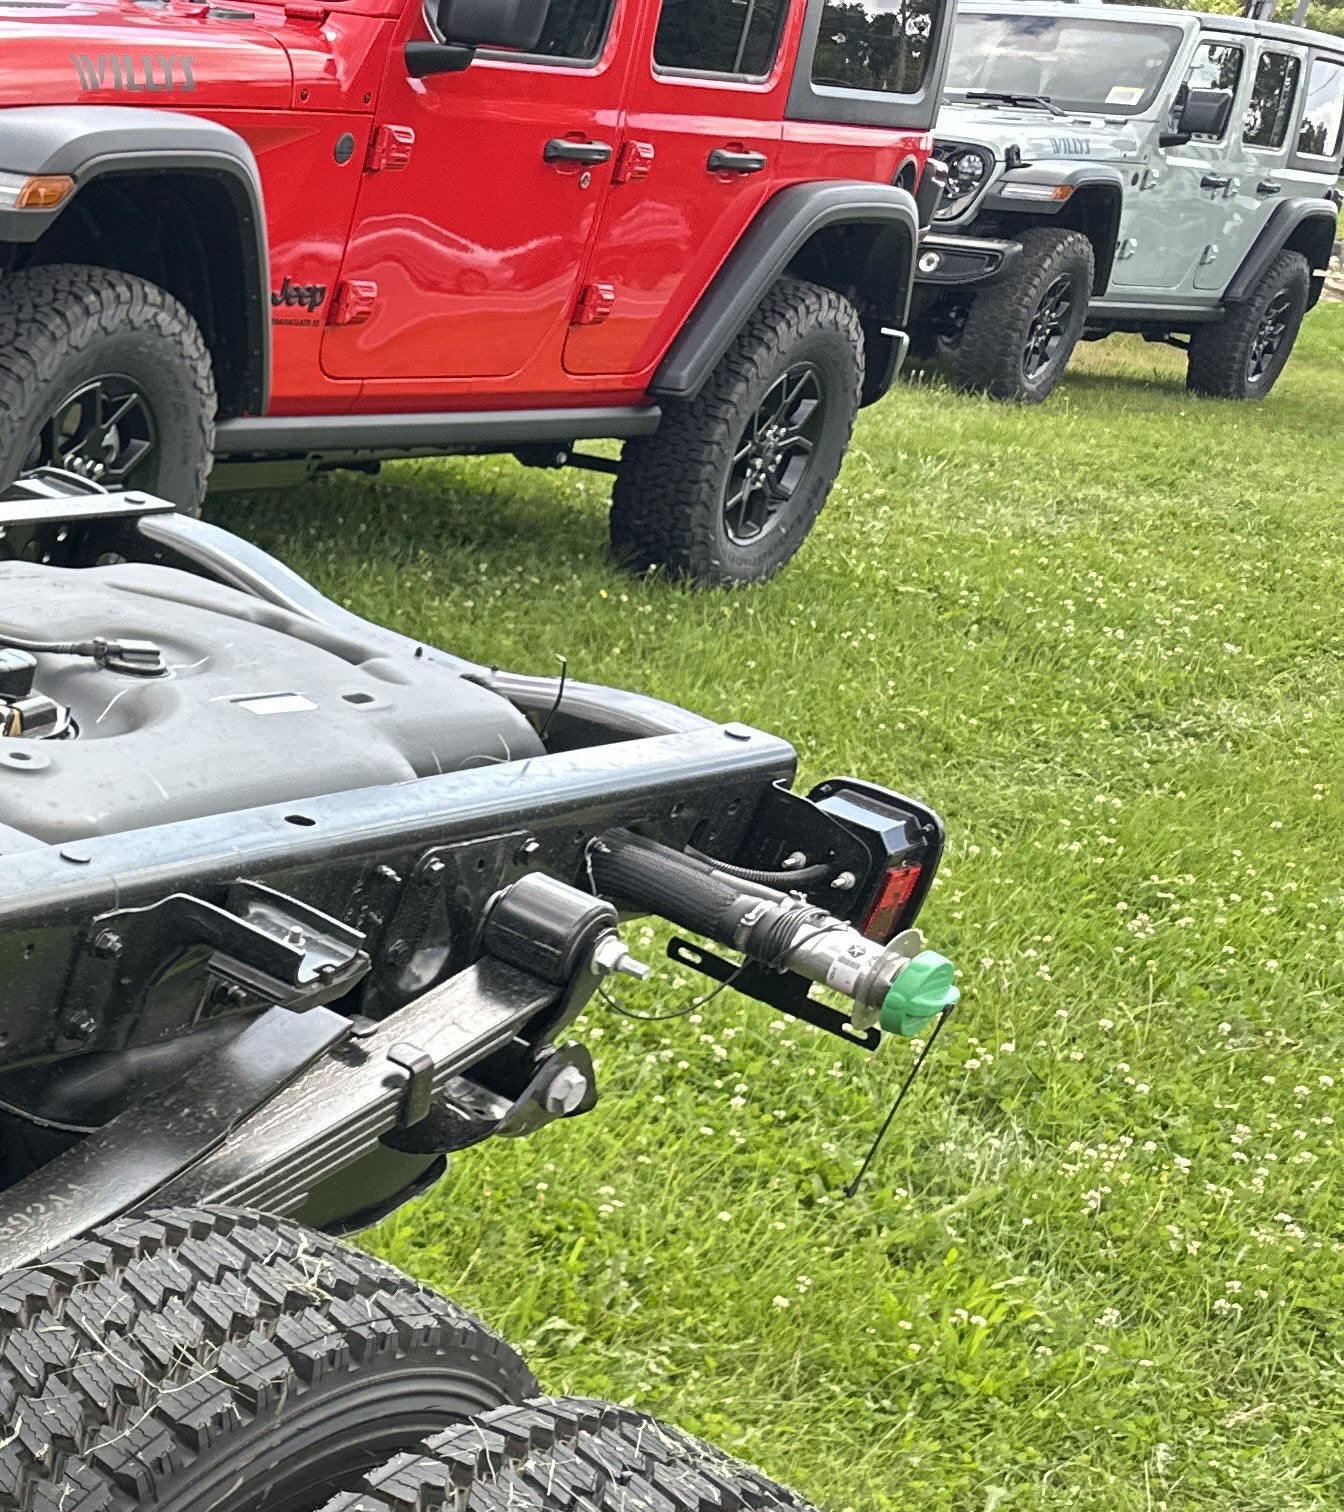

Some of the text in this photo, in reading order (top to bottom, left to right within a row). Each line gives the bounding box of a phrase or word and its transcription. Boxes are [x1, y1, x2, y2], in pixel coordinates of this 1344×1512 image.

[70, 54, 195, 93] WILLYS
[1048, 137, 1090, 154] WILLYS
[271, 276, 326, 312] Jeep
